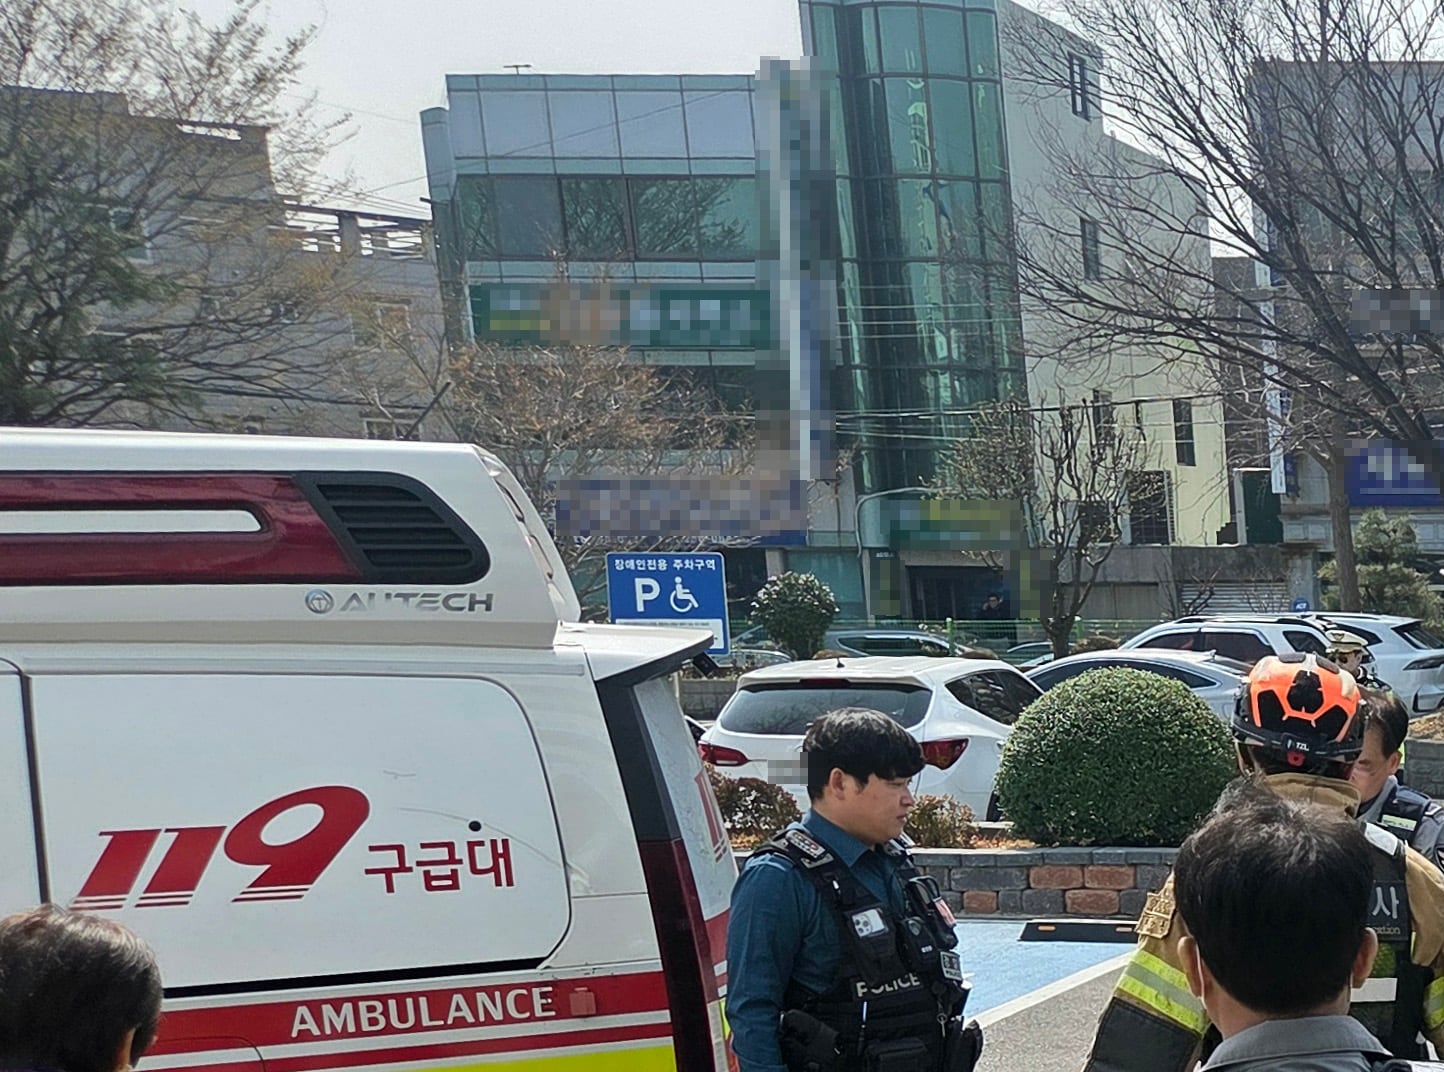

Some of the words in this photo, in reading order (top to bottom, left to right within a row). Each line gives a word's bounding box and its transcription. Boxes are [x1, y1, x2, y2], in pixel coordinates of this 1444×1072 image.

[614, 558, 668, 571] 장애인전용
[672, 558, 716, 571] 주차구역
[634, 577, 661, 613] P
[68, 785, 371, 911] 119
[364, 838, 515, 894] 구급대
[291, 986, 556, 1038] AMBULANCE
